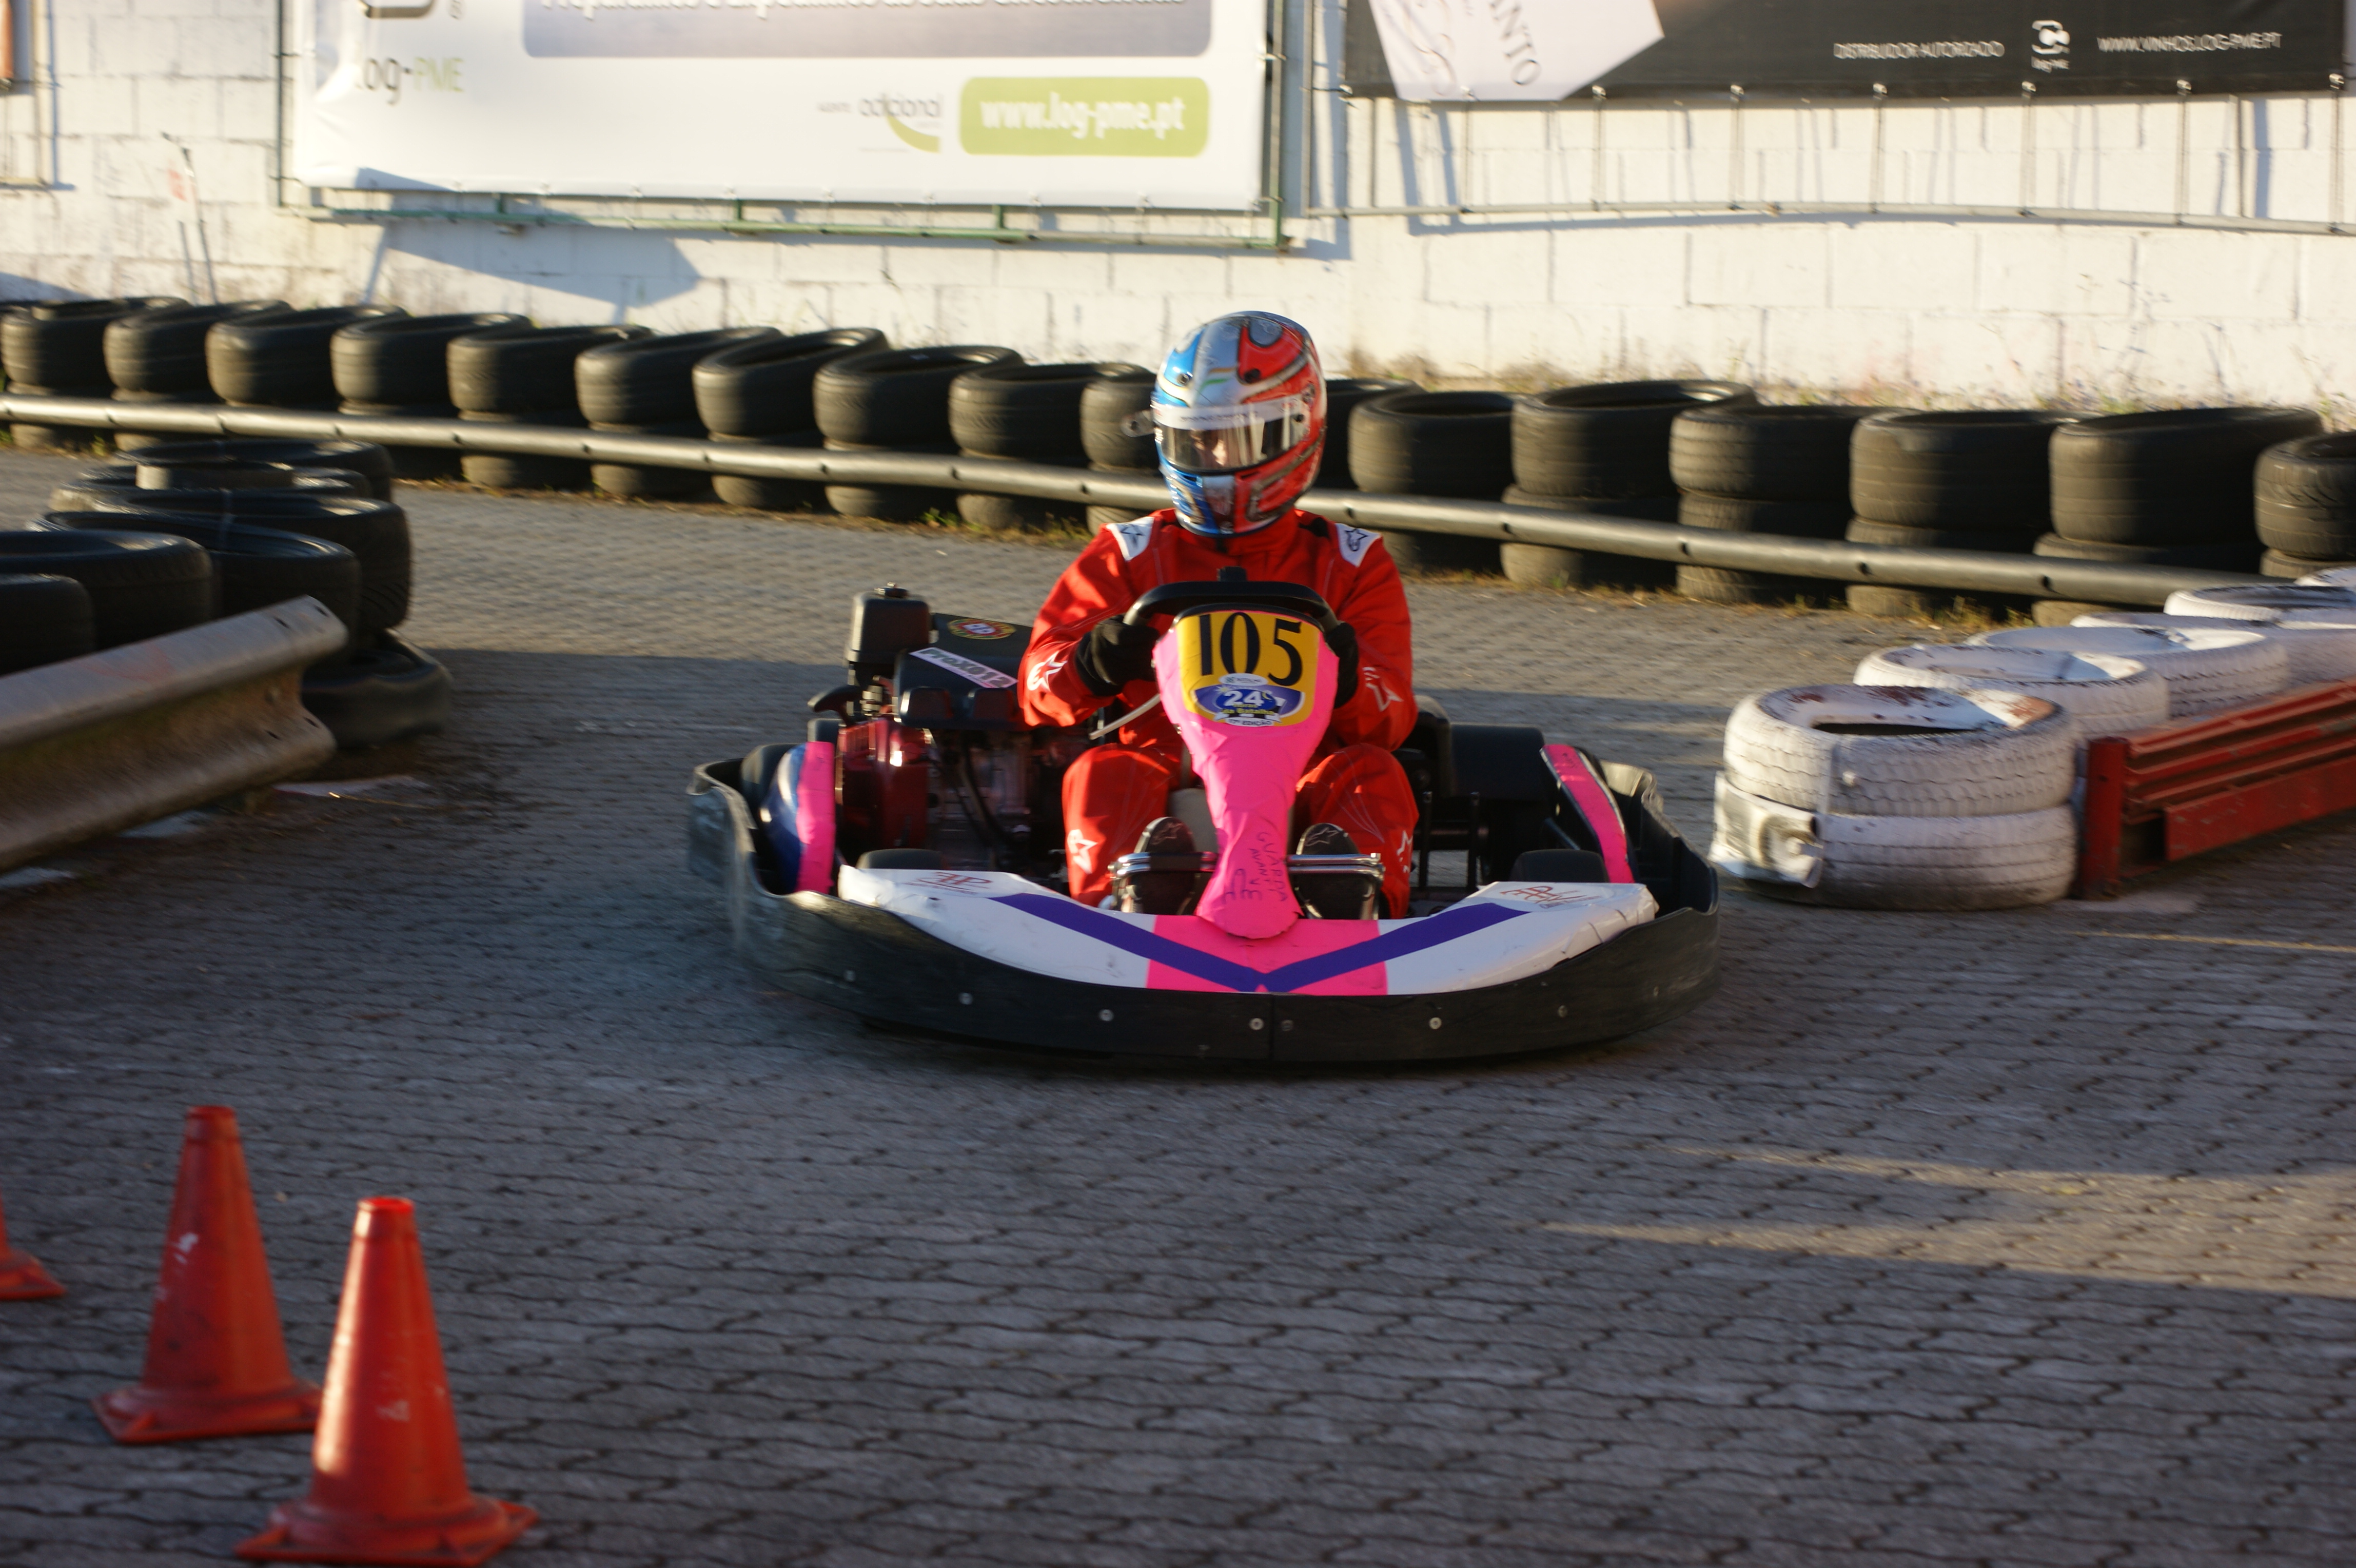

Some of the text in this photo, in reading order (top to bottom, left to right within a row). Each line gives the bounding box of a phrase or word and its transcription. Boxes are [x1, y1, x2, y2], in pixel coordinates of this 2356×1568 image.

[980, 91, 1185, 140] www.log-pme.pt
[1200, 612, 1303, 687] 105
[1223, 690, 1265, 707] 24
